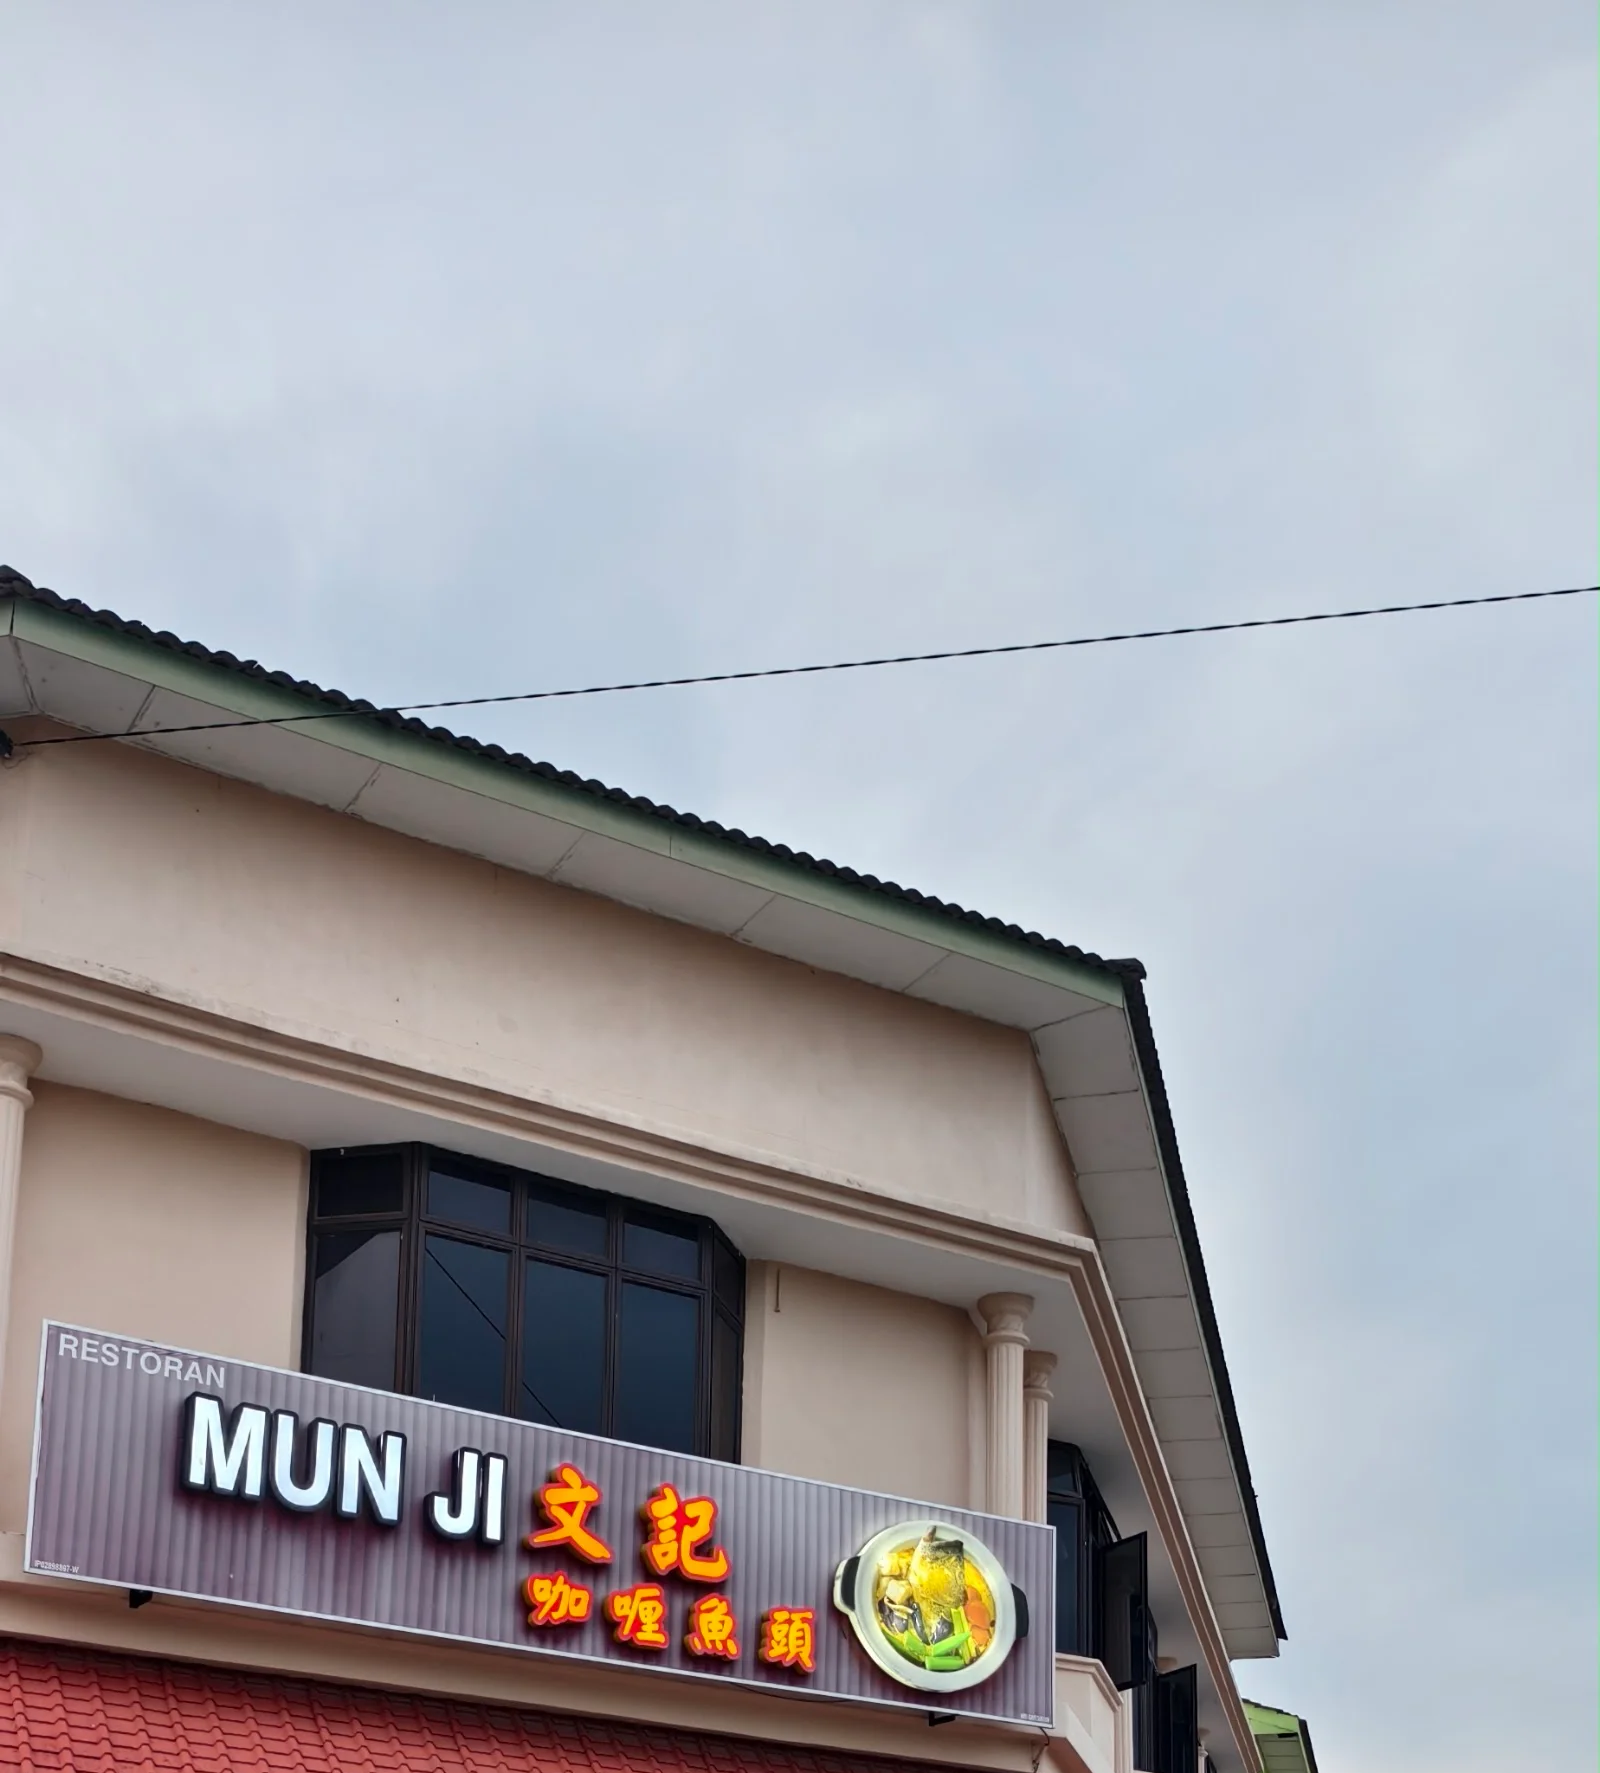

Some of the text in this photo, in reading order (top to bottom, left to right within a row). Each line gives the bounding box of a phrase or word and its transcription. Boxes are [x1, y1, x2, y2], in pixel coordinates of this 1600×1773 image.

[58, 1333, 226, 1389] RESTORAN
[184, 1392, 508, 1545] MUN JI
[526, 1463, 732, 1583] 文記
[524, 1571, 816, 1675] 咖喱魚頭
